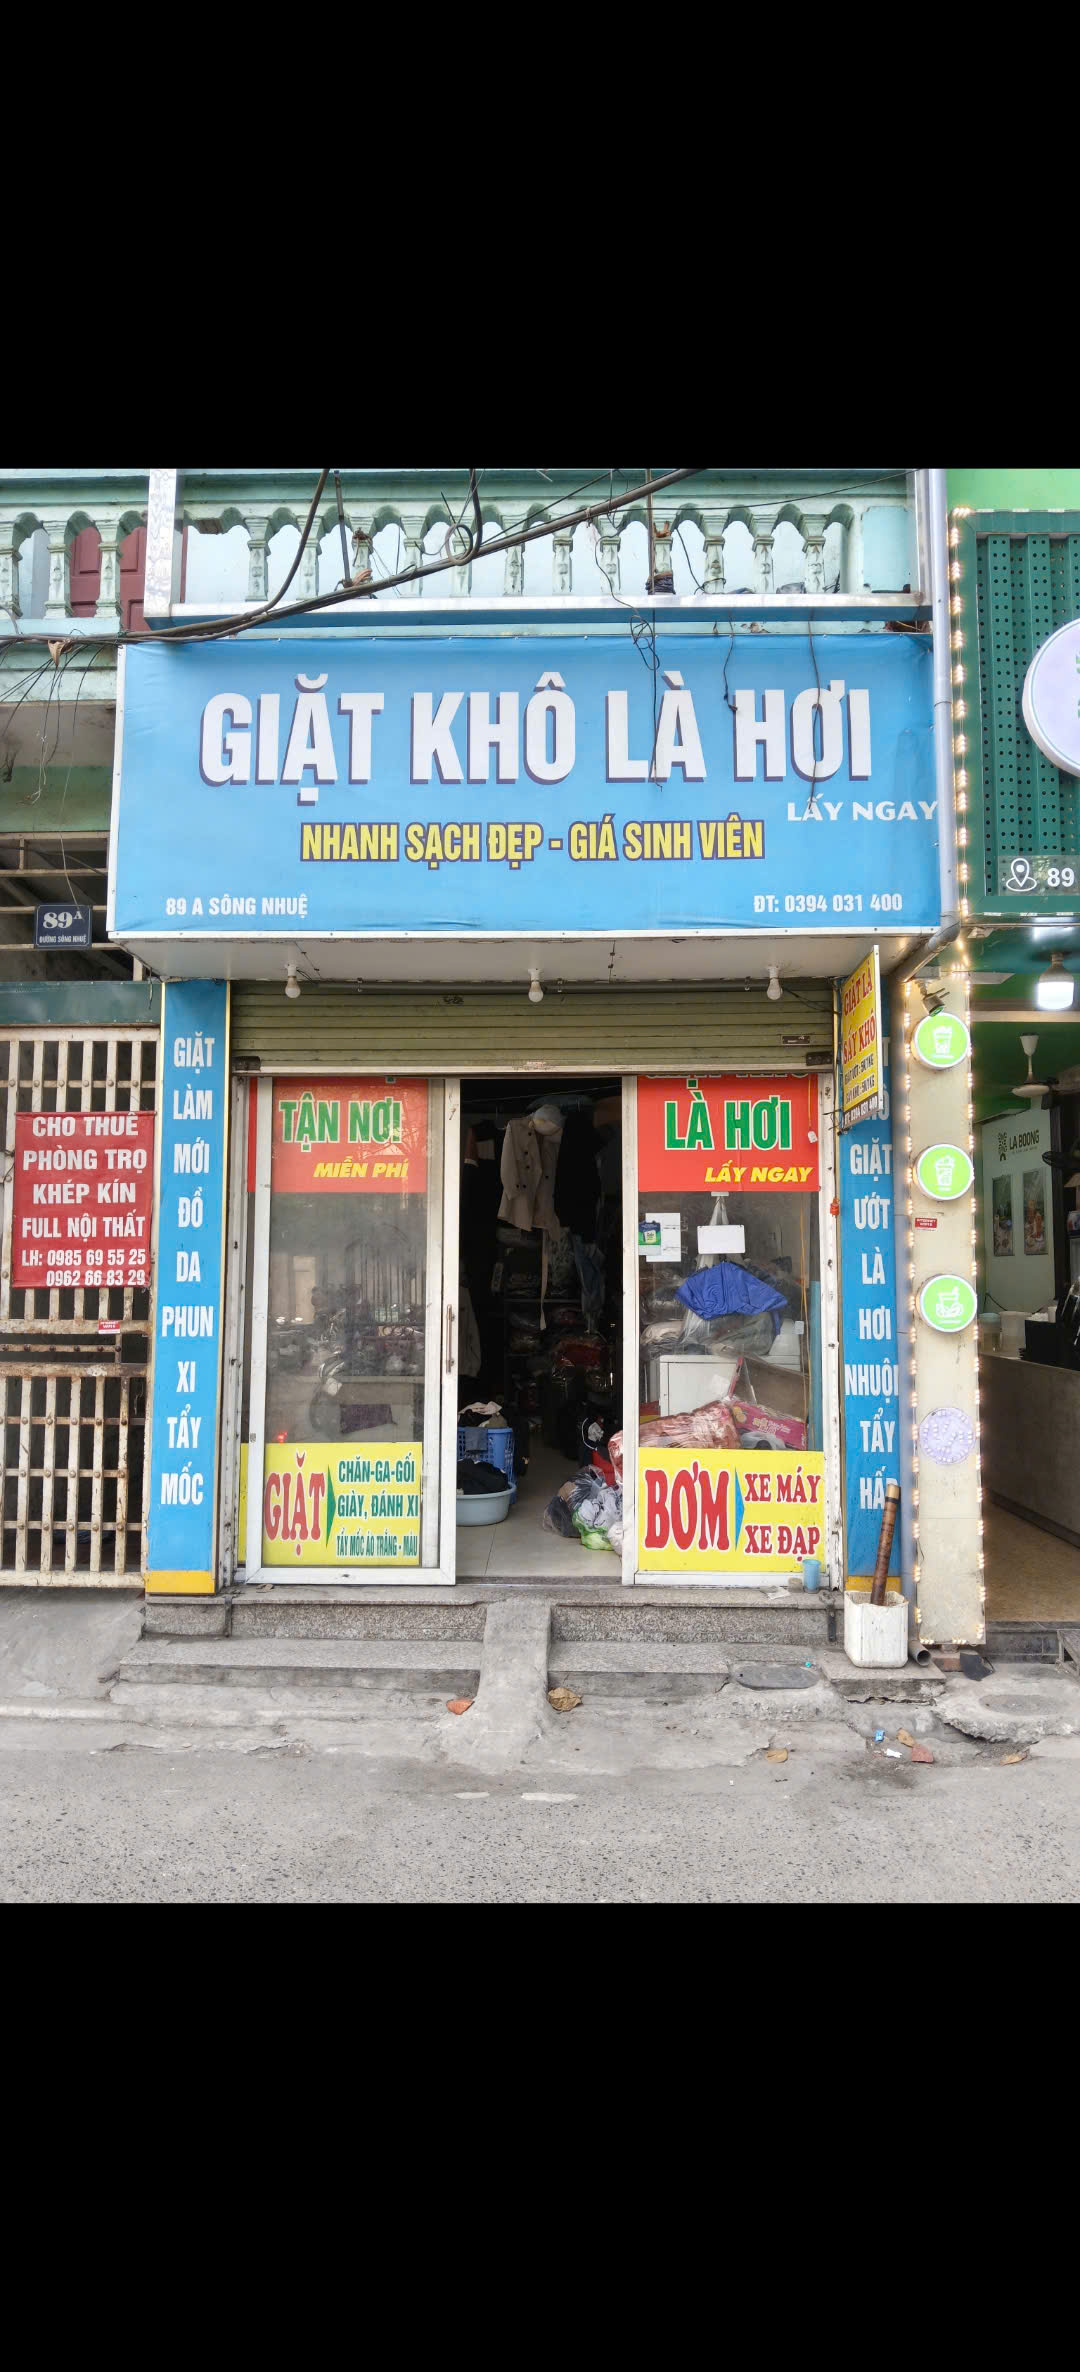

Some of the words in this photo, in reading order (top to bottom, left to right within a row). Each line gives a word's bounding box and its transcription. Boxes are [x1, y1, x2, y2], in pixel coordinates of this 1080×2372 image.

[200, 673, 385, 806] GIẶT
[410, 671, 576, 785] KHÔ
[605, 671, 707, 783] LÀ
[733, 679, 873, 782] HƠI
[788, 793, 843, 821] LẤY
[852, 800, 938, 820] NGAY
[300, 822, 400, 862] NHANH
[404, 822, 482, 870] SẠCH
[486, 822, 543, 870] ĐẸP
[548, 837, 564, 851] -
[568, 813, 619, 861] GIÁ
[623, 820, 693, 861] SINH
[697, 812, 765, 860] VIÊN
[1047, 867, 1075, 888] 89
[166, 897, 187, 916] 89
[192, 897, 203, 916] A
[208, 893, 256, 916] SÔNG
[262, 893, 308, 919] NHUỆ
[753, 895, 780, 913] ĐT:
[784, 894, 828, 913] 0394
[832, 894, 863, 912] 031
[870, 893, 903, 912] 400
[173, 1032, 215, 1074] GIẶT
[173, 1083, 213, 1120] LÀM
[664, 1089, 715, 1150] LÀ
[724, 1094, 792, 1150] HƠI
[32, 1116, 76, 1136] CHO
[84, 1111, 139, 1136] THUÊ
[279, 1091, 340, 1152] TẬN
[347, 1096, 402, 1144] NƠI
[1010, 1135, 1018, 1150] LA
[1018, 1129, 1040, 1148] BOONG
[23, 1144, 98, 1170] PHÒNG
[104, 1149, 148, 1174] TRỌ
[173, 1136, 210, 1174] MỚI
[313, 1155, 369, 1178] MIỄN
[371, 1157, 409, 1178] PHÍ
[704, 1159, 747, 1183] LẤY
[750, 1167, 813, 1183] NGAY
[850, 1138, 893, 1182] GIẶT
[33, 1178, 90, 1204] KHÉP
[97, 1178, 136, 1204] KÍN
[178, 1186, 204, 1228] ĐỒ
[22, 1217, 62, 1238] FULL
[67, 1212, 97, 1243] NỘI
[103, 1208, 146, 1237] THẤT
[854, 1191, 891, 1230] ƯỚT
[21, 1249, 42, 1266] LH:
[47, 1249, 82, 1266] 0985
[86, 1249, 103, 1266] 69
[107, 1249, 125, 1266] 55
[128, 1248, 146, 1265] 25
[176, 1251, 201, 1282] DA
[861, 1246, 886, 1285] LÀ
[46, 1270, 80, 1286] 0962
[84, 1269, 102, 1286] 66
[106, 1269, 124, 1286] 83
[127, 1269, 146, 1286] 29
[161, 1306, 214, 1337] PHUN
[858, 1305, 892, 1341] HƠI
[176, 1361, 196, 1393] XI
[167, 1403, 202, 1449] TẨY
[859, 1407, 896, 1453] TẨY
[160, 1461, 204, 1505] MỐC
[338, 1451, 416, 1482] CHĂN-GA-GỐI
[744, 1473, 772, 1502] XE
[776, 1466, 821, 1503] MÁY
[264, 1451, 326, 1556] GIẶT
[337, 1490, 368, 1519] GIÀY,
[371, 1490, 404, 1517] ĐÁNH
[406, 1495, 419, 1517] XI
[644, 1460, 730, 1551] BƠM
[744, 1525, 773, 1554] XE
[777, 1525, 821, 1562] ĐẠP
